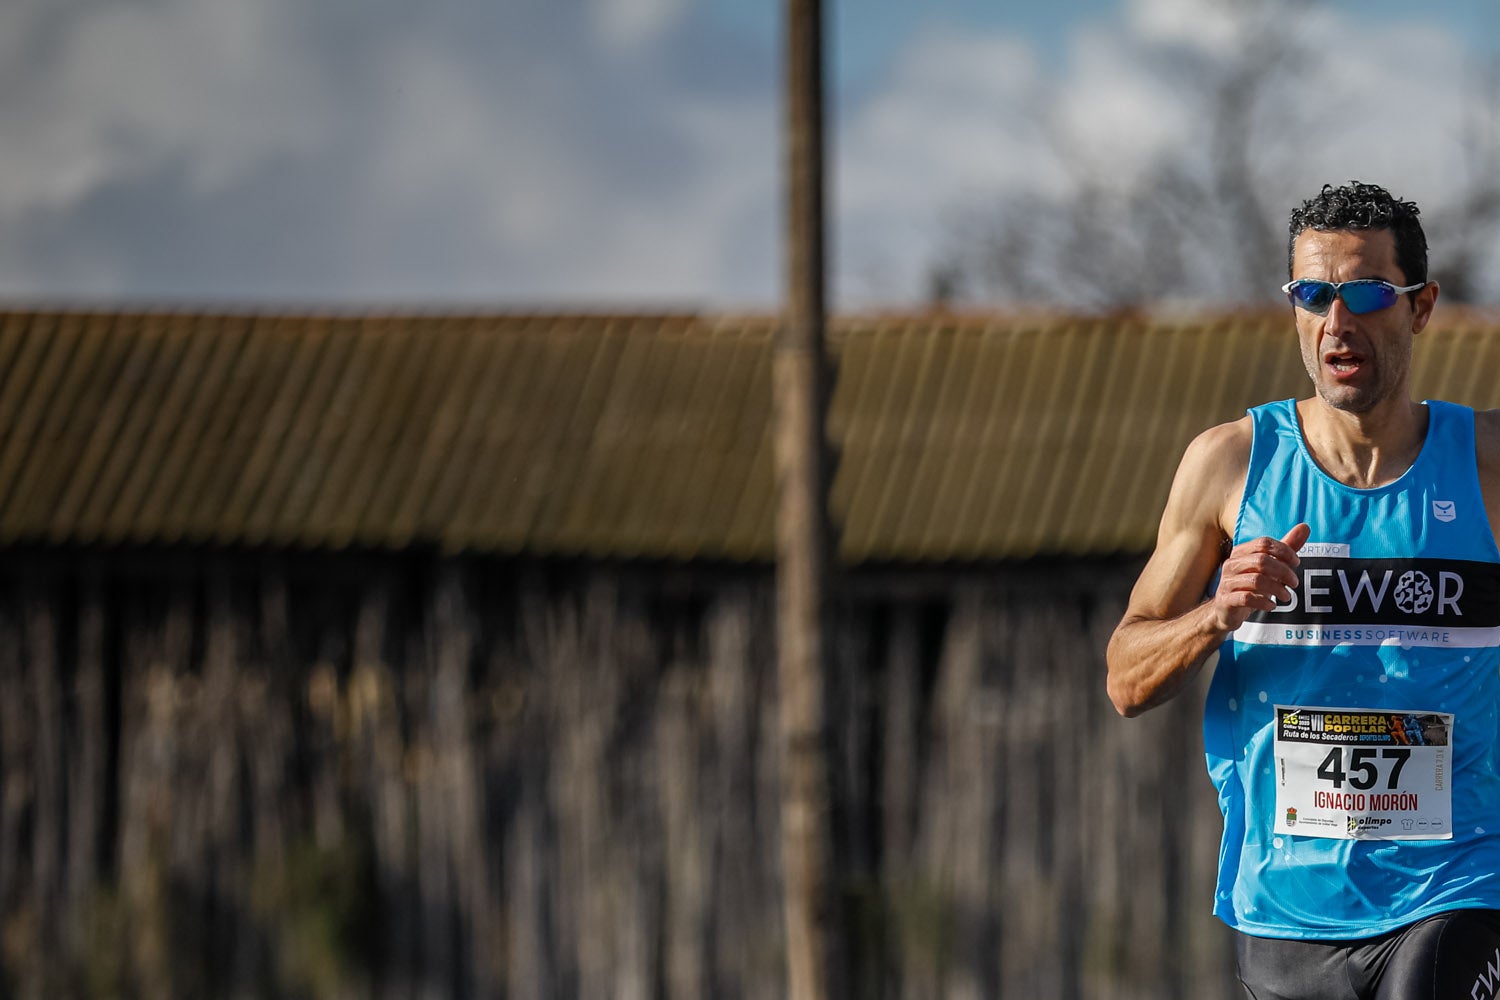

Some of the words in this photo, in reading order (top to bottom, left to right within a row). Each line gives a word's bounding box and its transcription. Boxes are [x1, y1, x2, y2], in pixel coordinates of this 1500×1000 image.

[1299, 546, 1340, 554] ORTIVO
[1311, 715, 1324, 732] VII
[1324, 714, 1387, 725] CARRERA
[1324, 724, 1387, 733] POPULAR
[1283, 730, 1299, 738] Ruta
[1321, 732, 1358, 741] Secaderos
[1317, 747, 1411, 790] 457
[1314, 791, 1365, 811] IGNACIO
[1369, 791, 1418, 812] MORÓN
[1359, 817, 1392, 827] olimpo
